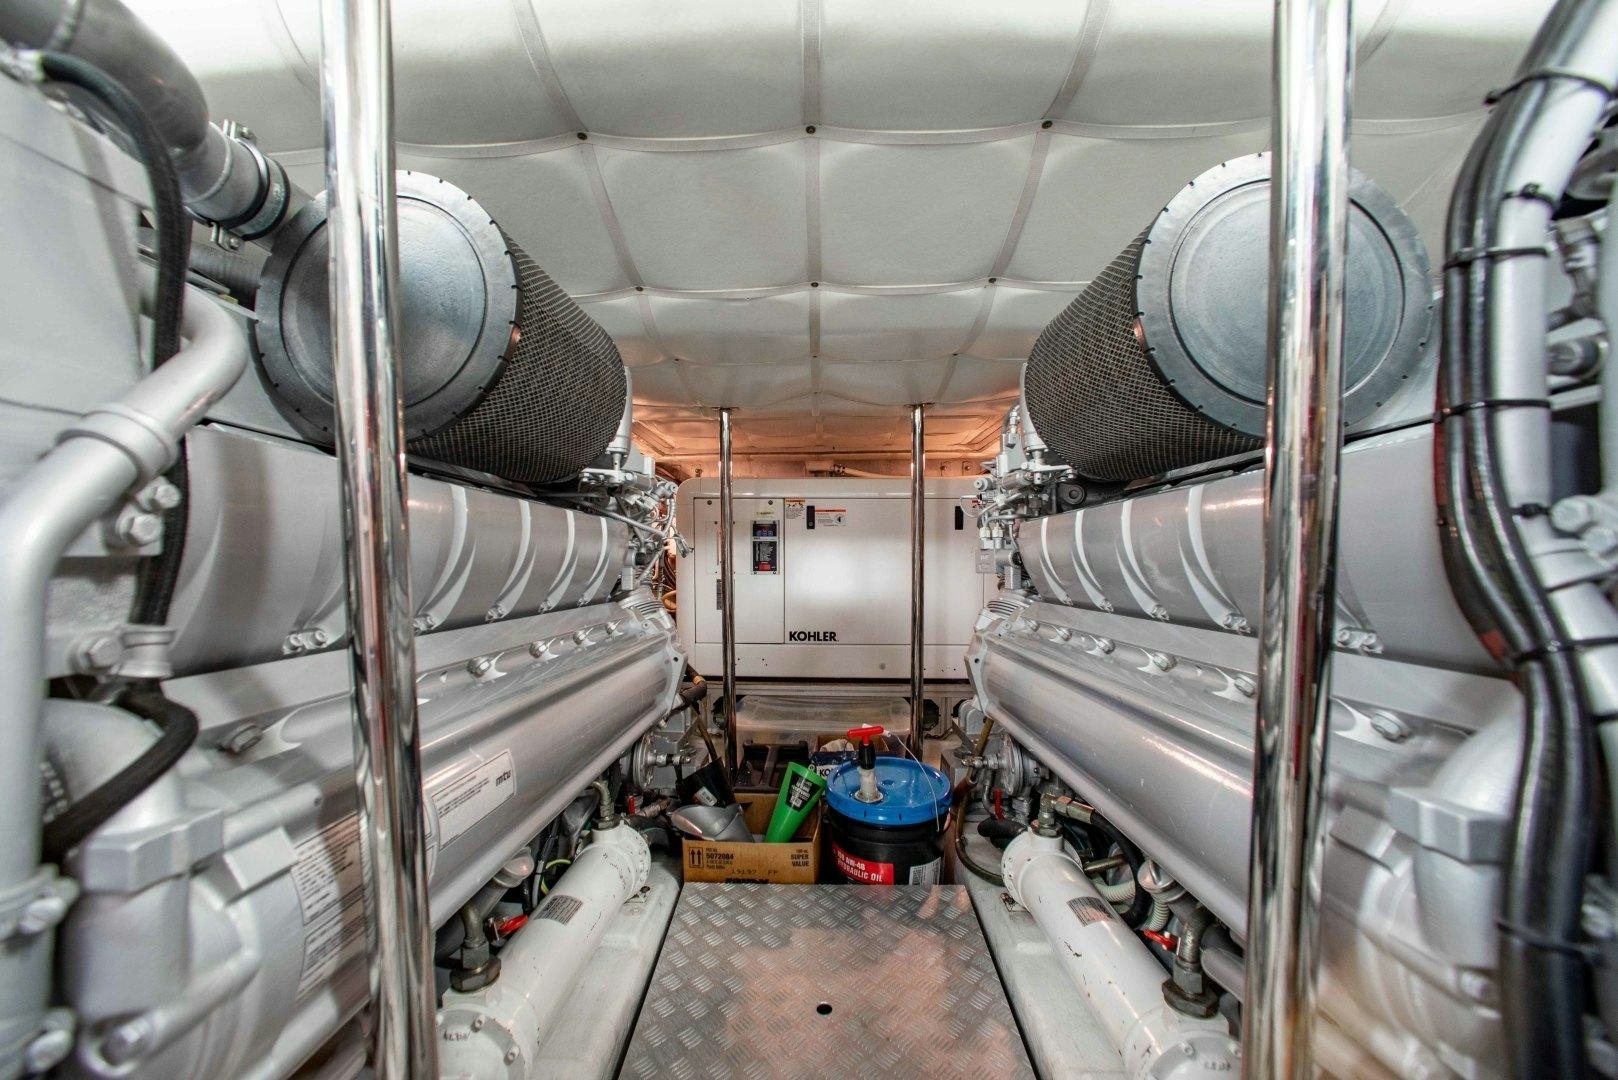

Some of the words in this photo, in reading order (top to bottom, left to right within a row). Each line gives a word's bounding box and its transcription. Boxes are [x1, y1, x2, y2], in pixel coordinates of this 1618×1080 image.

[788, 631, 837, 642] KOHLER
[495, 769, 511, 786] mtu
[870, 873, 883, 882] OIL
